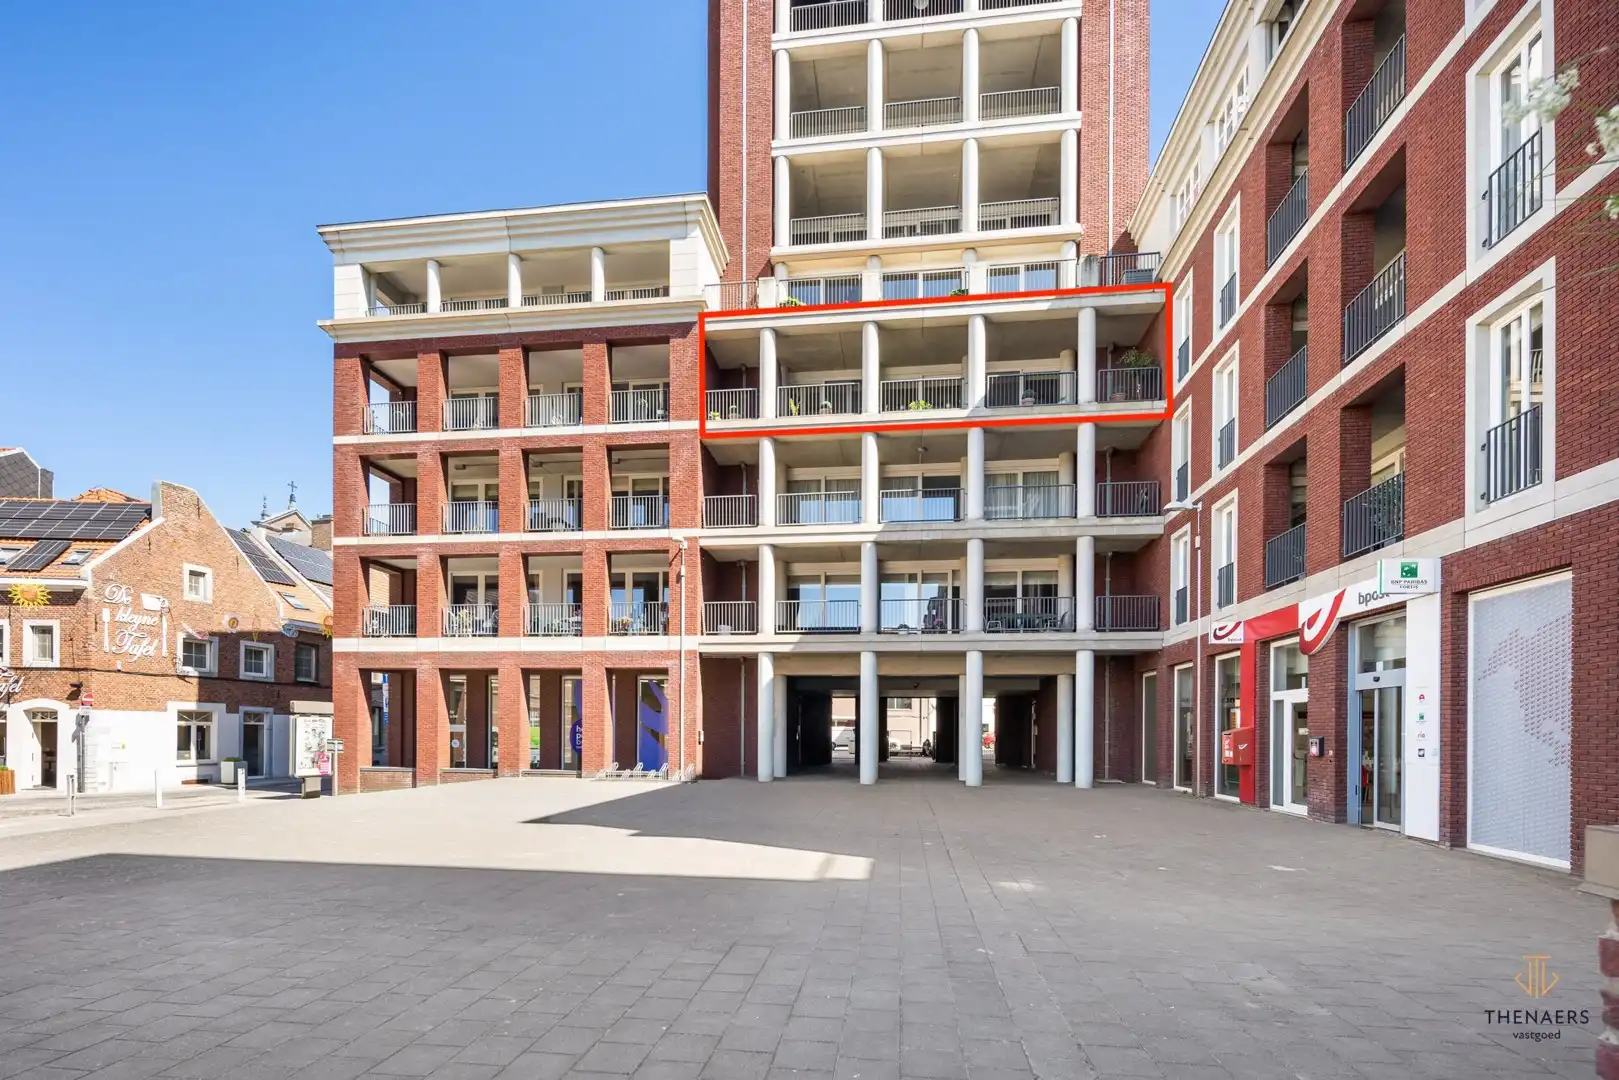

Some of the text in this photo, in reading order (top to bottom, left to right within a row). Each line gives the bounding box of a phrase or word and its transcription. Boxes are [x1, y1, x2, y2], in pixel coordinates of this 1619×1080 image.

[103, 583, 134, 605] De
[1358, 590, 1390, 606] bpos
[111, 629, 160, 662] Tafel
